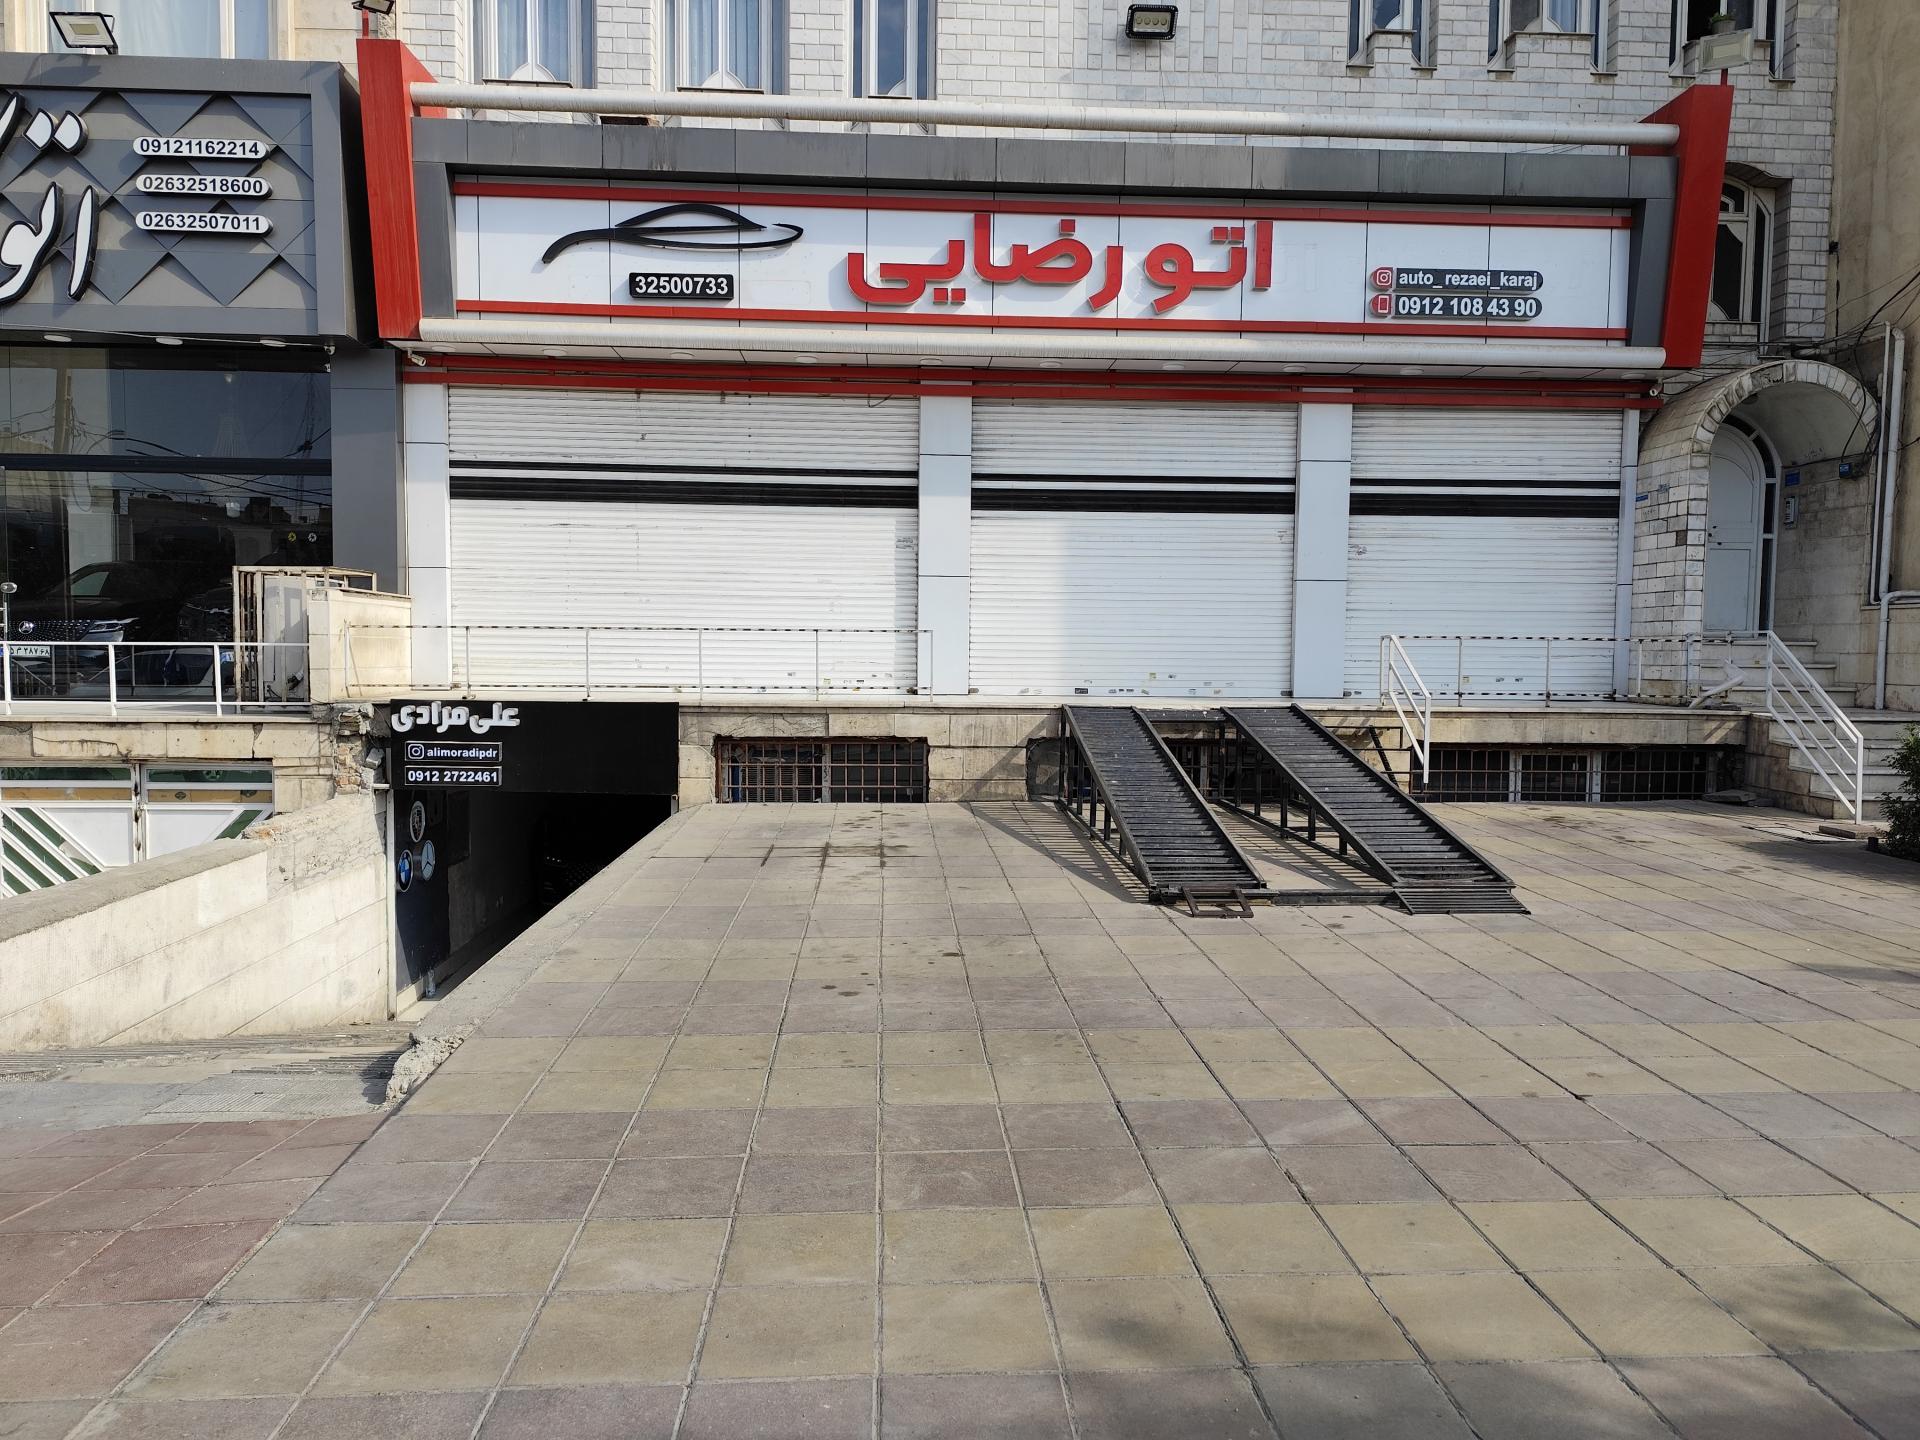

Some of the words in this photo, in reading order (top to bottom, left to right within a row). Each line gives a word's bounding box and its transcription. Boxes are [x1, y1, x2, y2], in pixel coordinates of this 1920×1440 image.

[139, 138, 260, 157] 09121162214
[142, 176, 263, 195] 02632518600
[142, 212, 261, 231] 02632507011
[634, 275, 729, 295] 32500733
[1398, 296, 1444, 315] 0912
[1450, 297, 1484, 316] 108
[1487, 298, 1510, 317] 43
[1514, 298, 1537, 317] 90
[391, 700, 470, 734] مرادی
[469, 701, 521, 735] علی
[426, 747, 498, 760] alimoradipdr
[407, 770, 440, 782] 0912
[443, 771, 497, 783] 2722461
